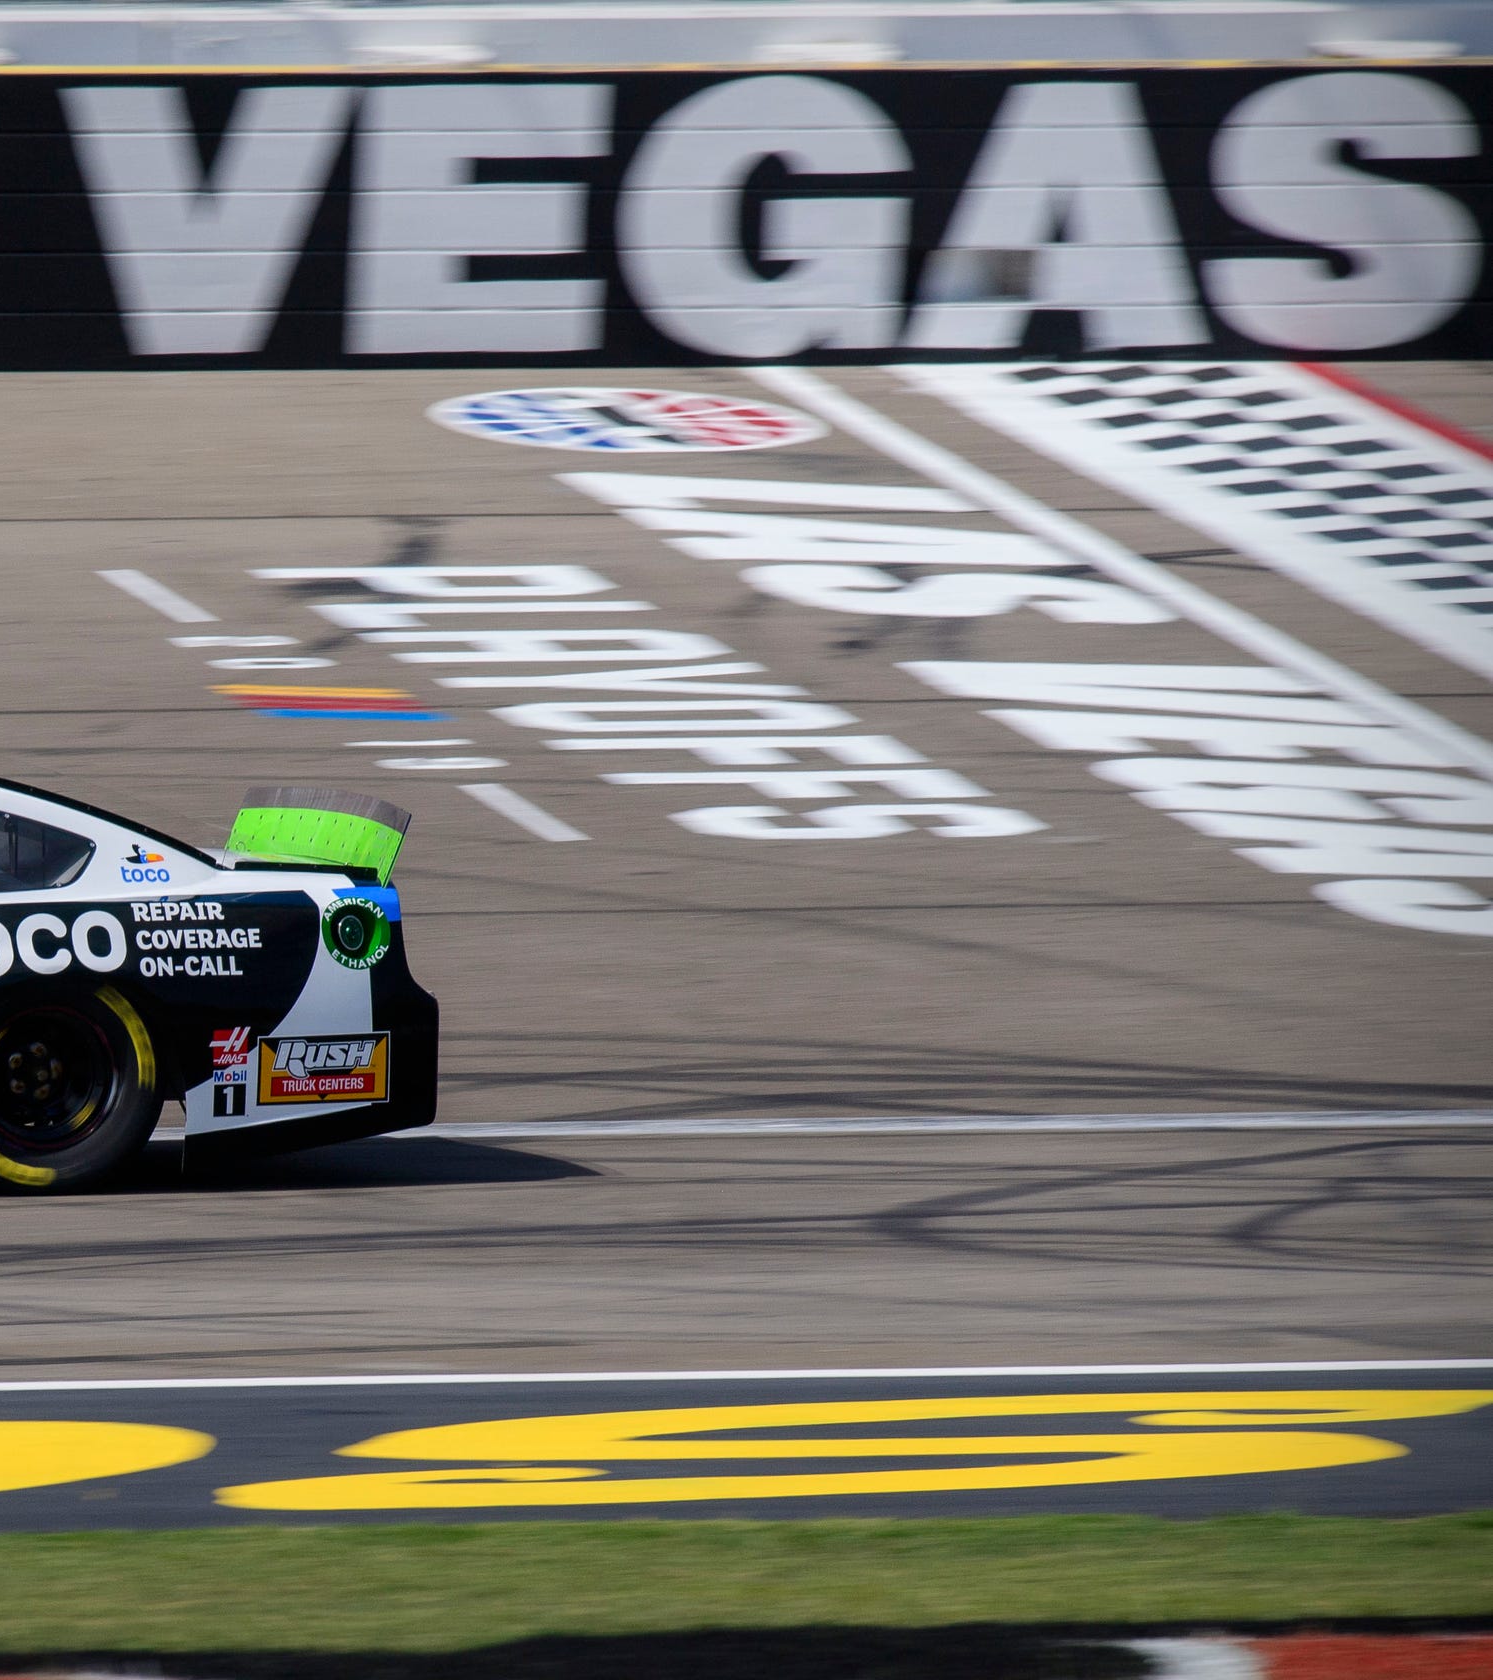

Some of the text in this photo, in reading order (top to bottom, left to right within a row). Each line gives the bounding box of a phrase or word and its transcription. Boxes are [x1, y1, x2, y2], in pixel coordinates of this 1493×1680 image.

[58, 72, 1483, 358] VEGAS
[554, 472, 1181, 625] LAS
[248, 564, 1050, 839] PLAYOFFS
[121, 865, 170, 883] toco
[131, 902, 225, 922] REPAIR
[323, 897, 384, 922] AMERICAN
[135, 928, 262, 950] COVERAGE
[140, 956, 243, 977] ON-CALL
[331, 945, 389, 969] ETHANOL
[272, 1039, 376, 1079] RUSH
[214, 1070, 247, 1083] Mobil
[282, 1076, 364, 1093] TRUCK CENTERS
